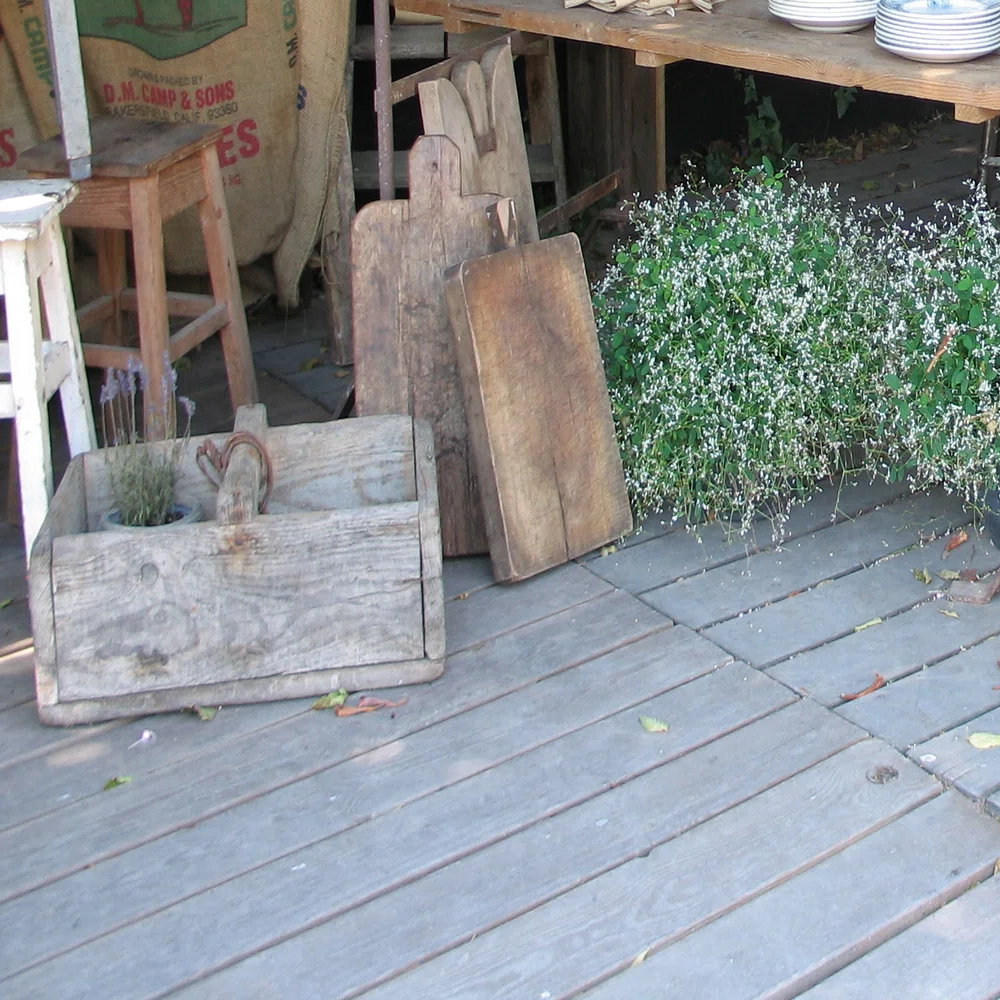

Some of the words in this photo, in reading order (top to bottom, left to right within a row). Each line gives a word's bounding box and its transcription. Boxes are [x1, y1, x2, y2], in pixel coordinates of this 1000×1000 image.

[191, 75, 203, 85] BY
[103, 81, 138, 103] D.M.
[141, 84, 177, 108] CAMP
[181, 90, 192, 110] &
[195, 80, 235, 109] SONS
